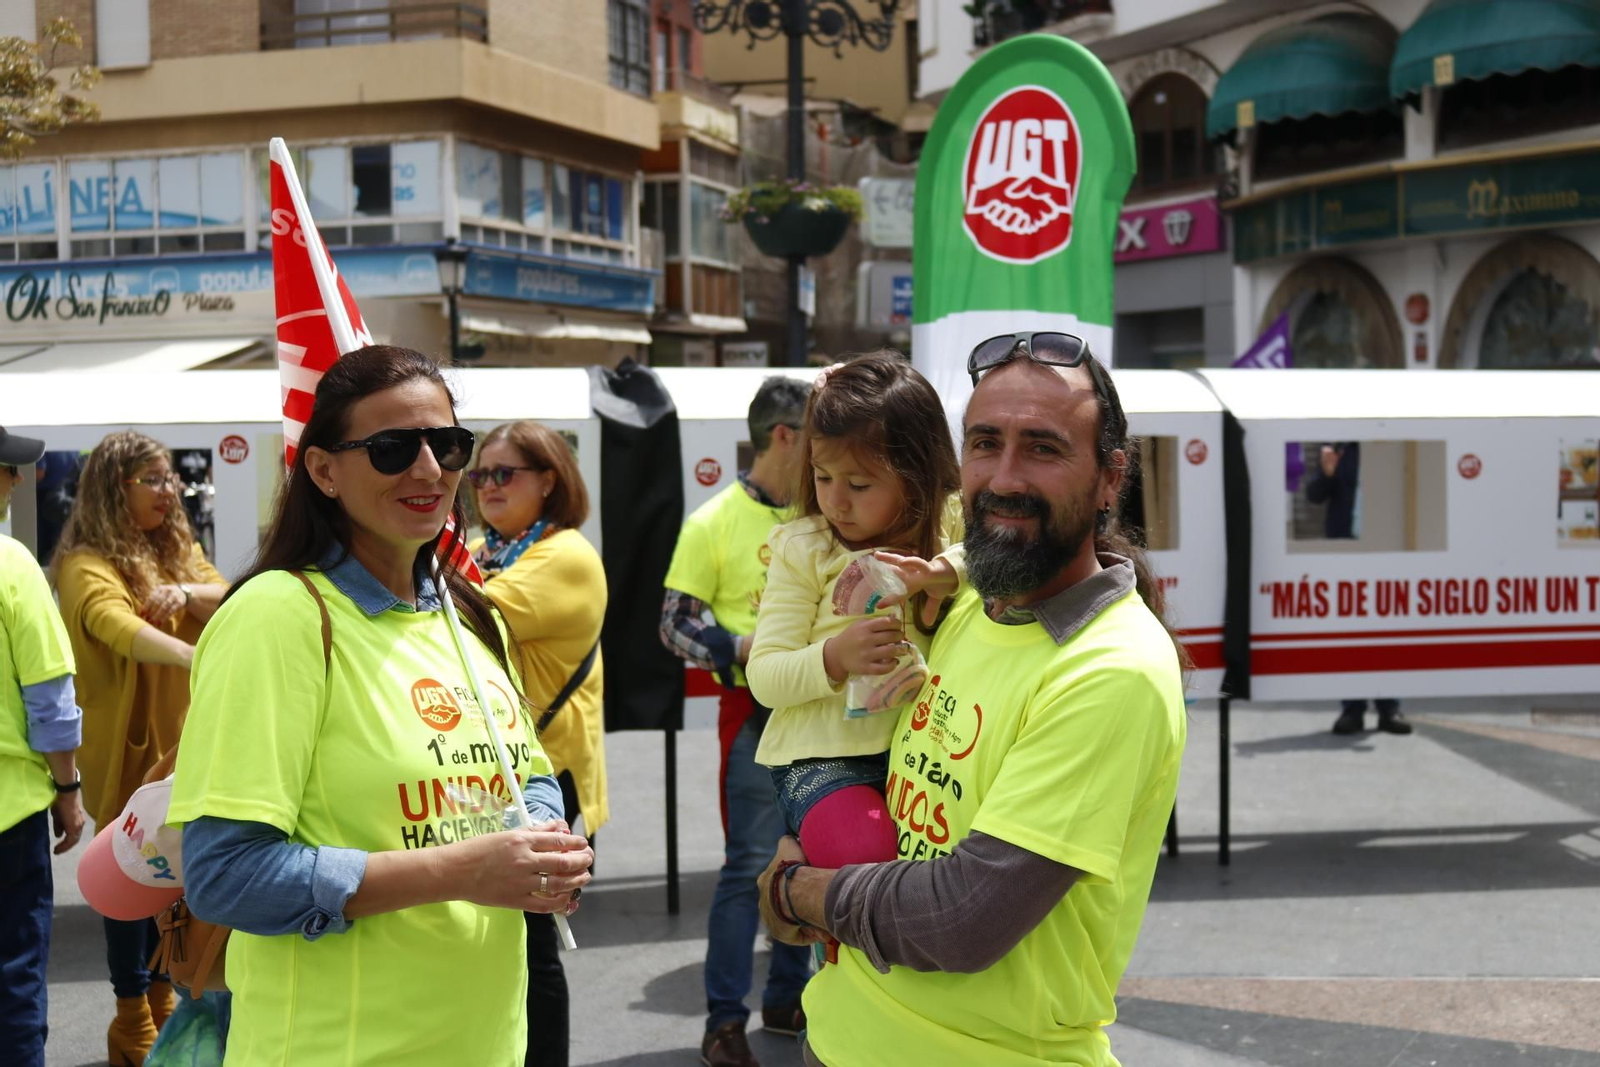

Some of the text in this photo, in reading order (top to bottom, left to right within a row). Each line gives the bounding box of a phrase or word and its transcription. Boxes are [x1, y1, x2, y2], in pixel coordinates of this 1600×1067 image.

[973, 118, 1068, 189] UGT
[199, 265, 273, 293] popula
[182, 292, 235, 312] Plaza
[1337, 580, 1369, 618] DE
[1376, 579, 1410, 617] UN
[1417, 578, 1490, 616] SIGLO
[1496, 577, 1539, 614] SIN
[1546, 576, 1579, 613] UN
[413, 686, 452, 708] UGT
[454, 687, 479, 702] FIC
[451, 750, 469, 765] de
[886, 770, 950, 845] IDOS
[122, 812, 176, 881] HAPPY
